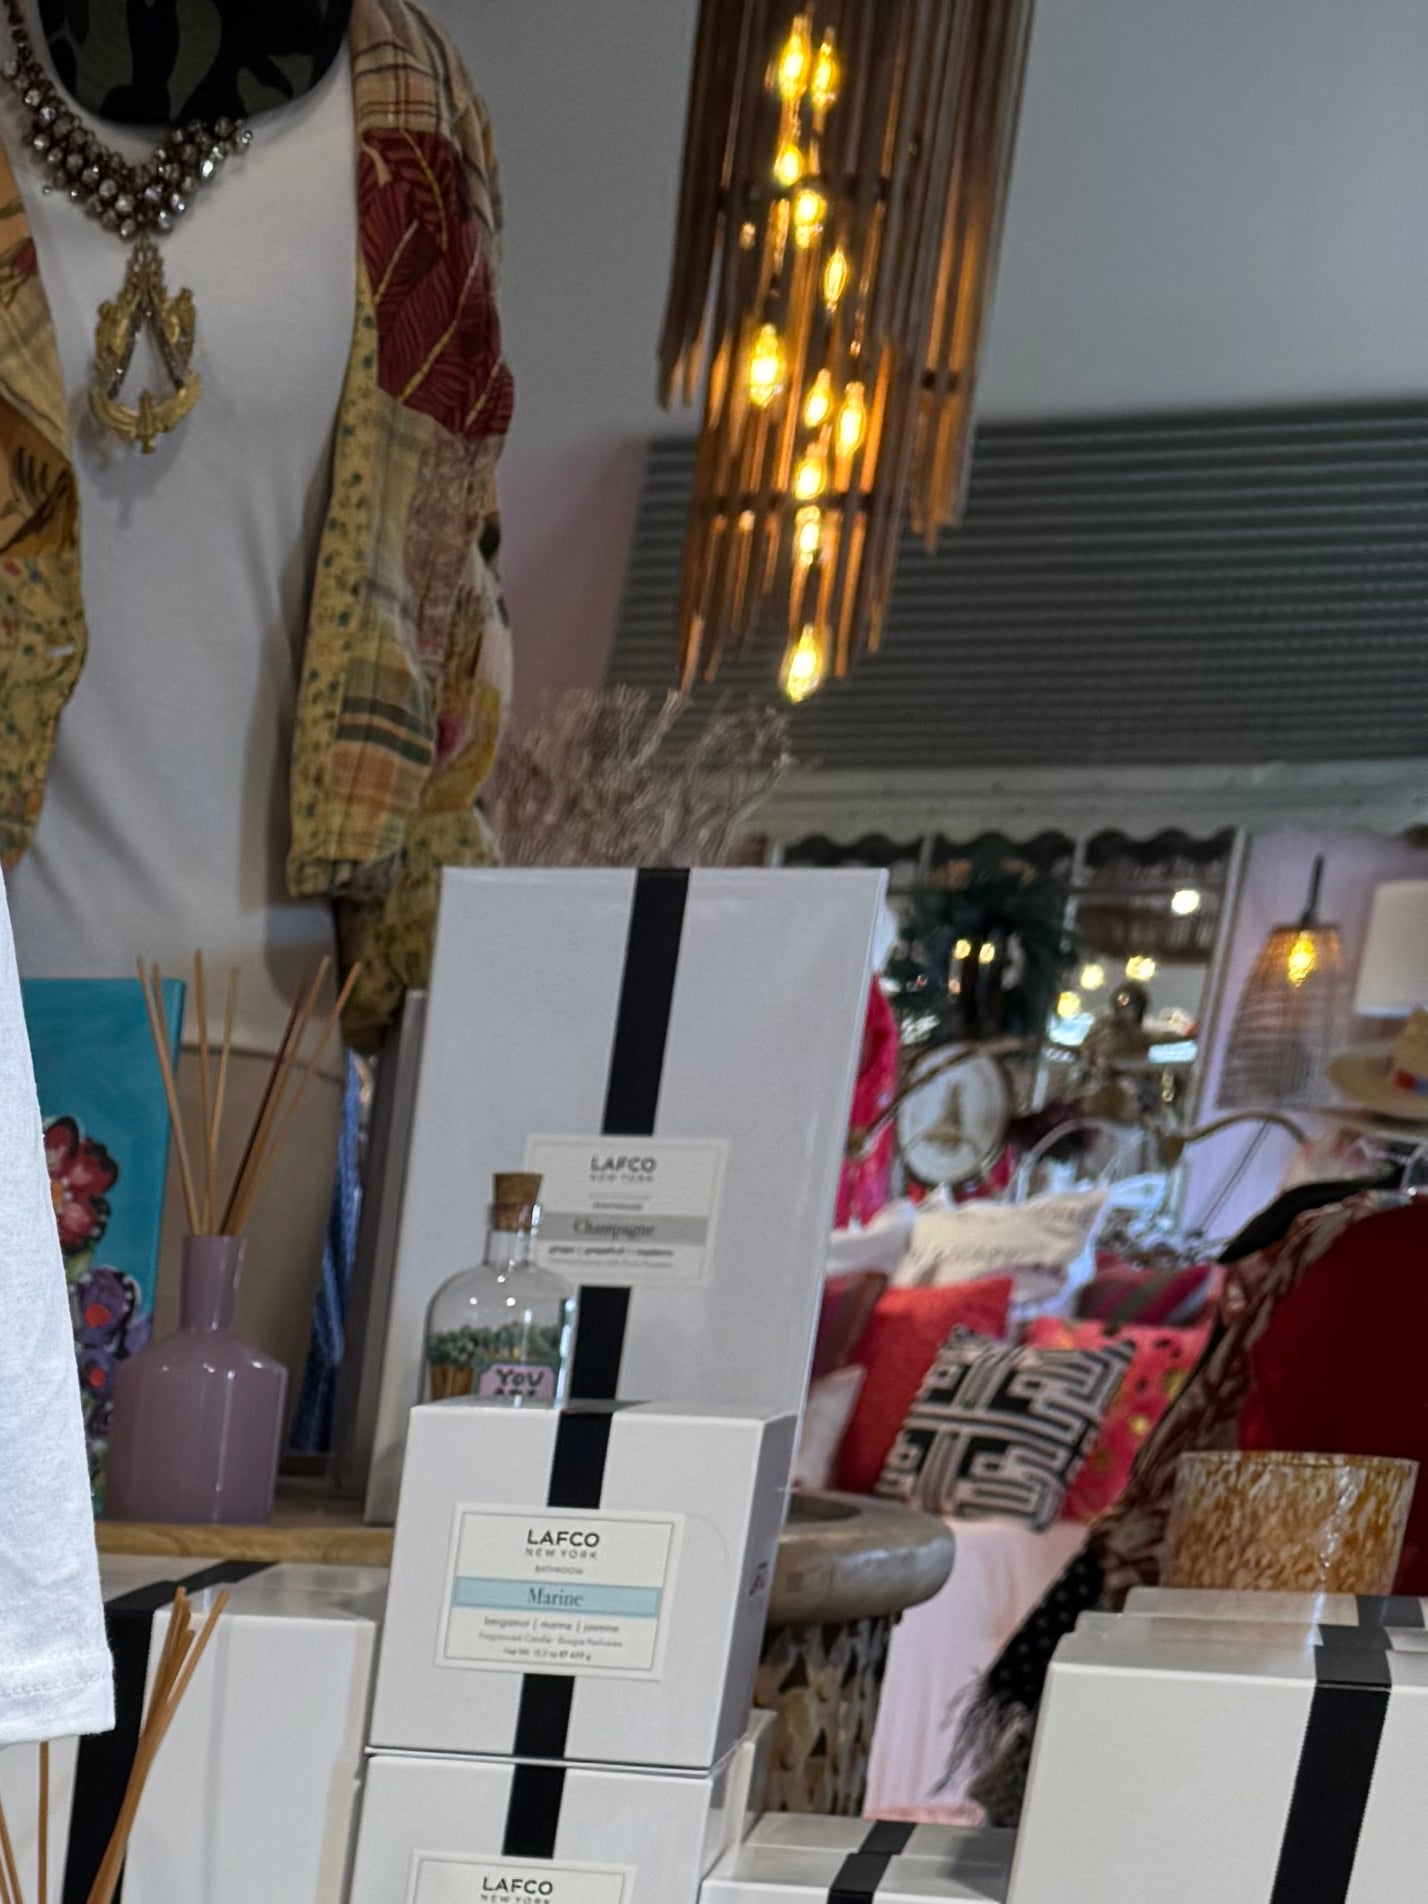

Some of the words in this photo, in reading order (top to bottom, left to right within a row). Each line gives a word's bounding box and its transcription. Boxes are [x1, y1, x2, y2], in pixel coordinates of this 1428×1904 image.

[590, 1156, 658, 1173] LAFCO
[573, 1218, 657, 1240] Champagne
[495, 1368, 545, 1387] YOU
[527, 1529, 600, 1548] LAFCO
[525, 1547, 556, 1557] NEW
[561, 1549, 598, 1560] YORK
[528, 1587, 585, 1607] Marine
[482, 1876, 553, 1896] LAFCO
[480, 1893, 510, 1903] NEW
